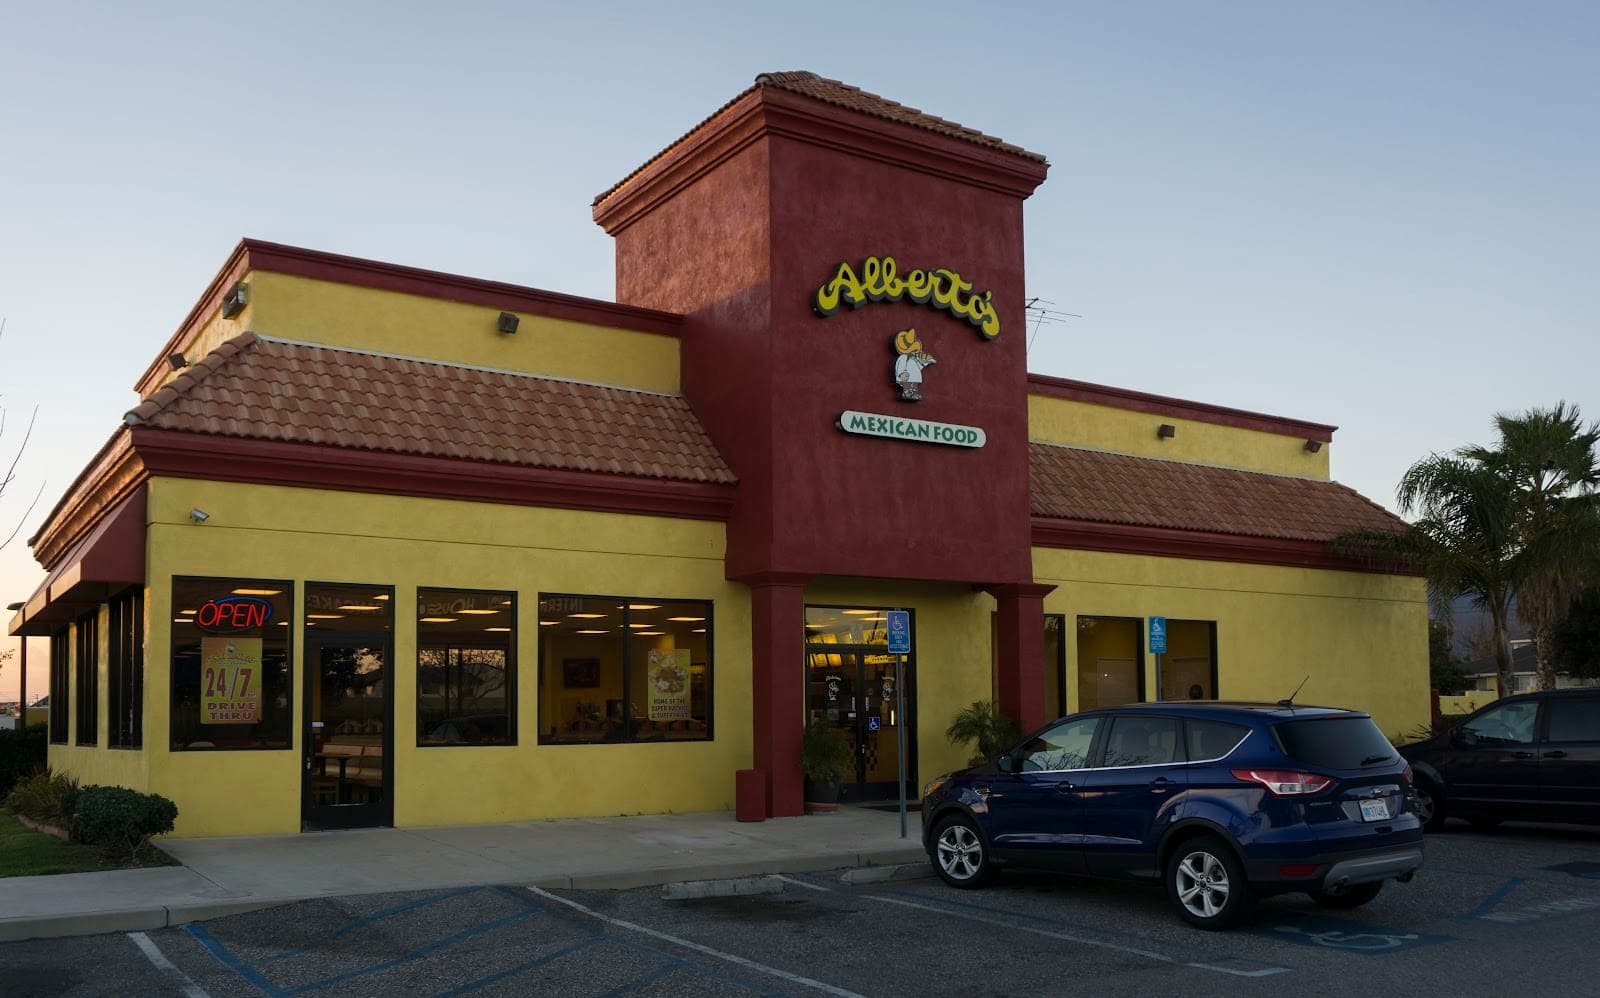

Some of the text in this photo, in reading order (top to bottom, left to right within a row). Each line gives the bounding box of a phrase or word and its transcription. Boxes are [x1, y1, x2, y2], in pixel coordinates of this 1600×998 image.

[816, 255, 1000, 338] Alberto's
[849, 414, 978, 445] MEXICAN FOOD
[197, 602, 267, 628] OPEN
[205, 667, 252, 700] 24/7
[207, 702, 256, 710] DRIVE
[209, 712, 252, 720] THRU
